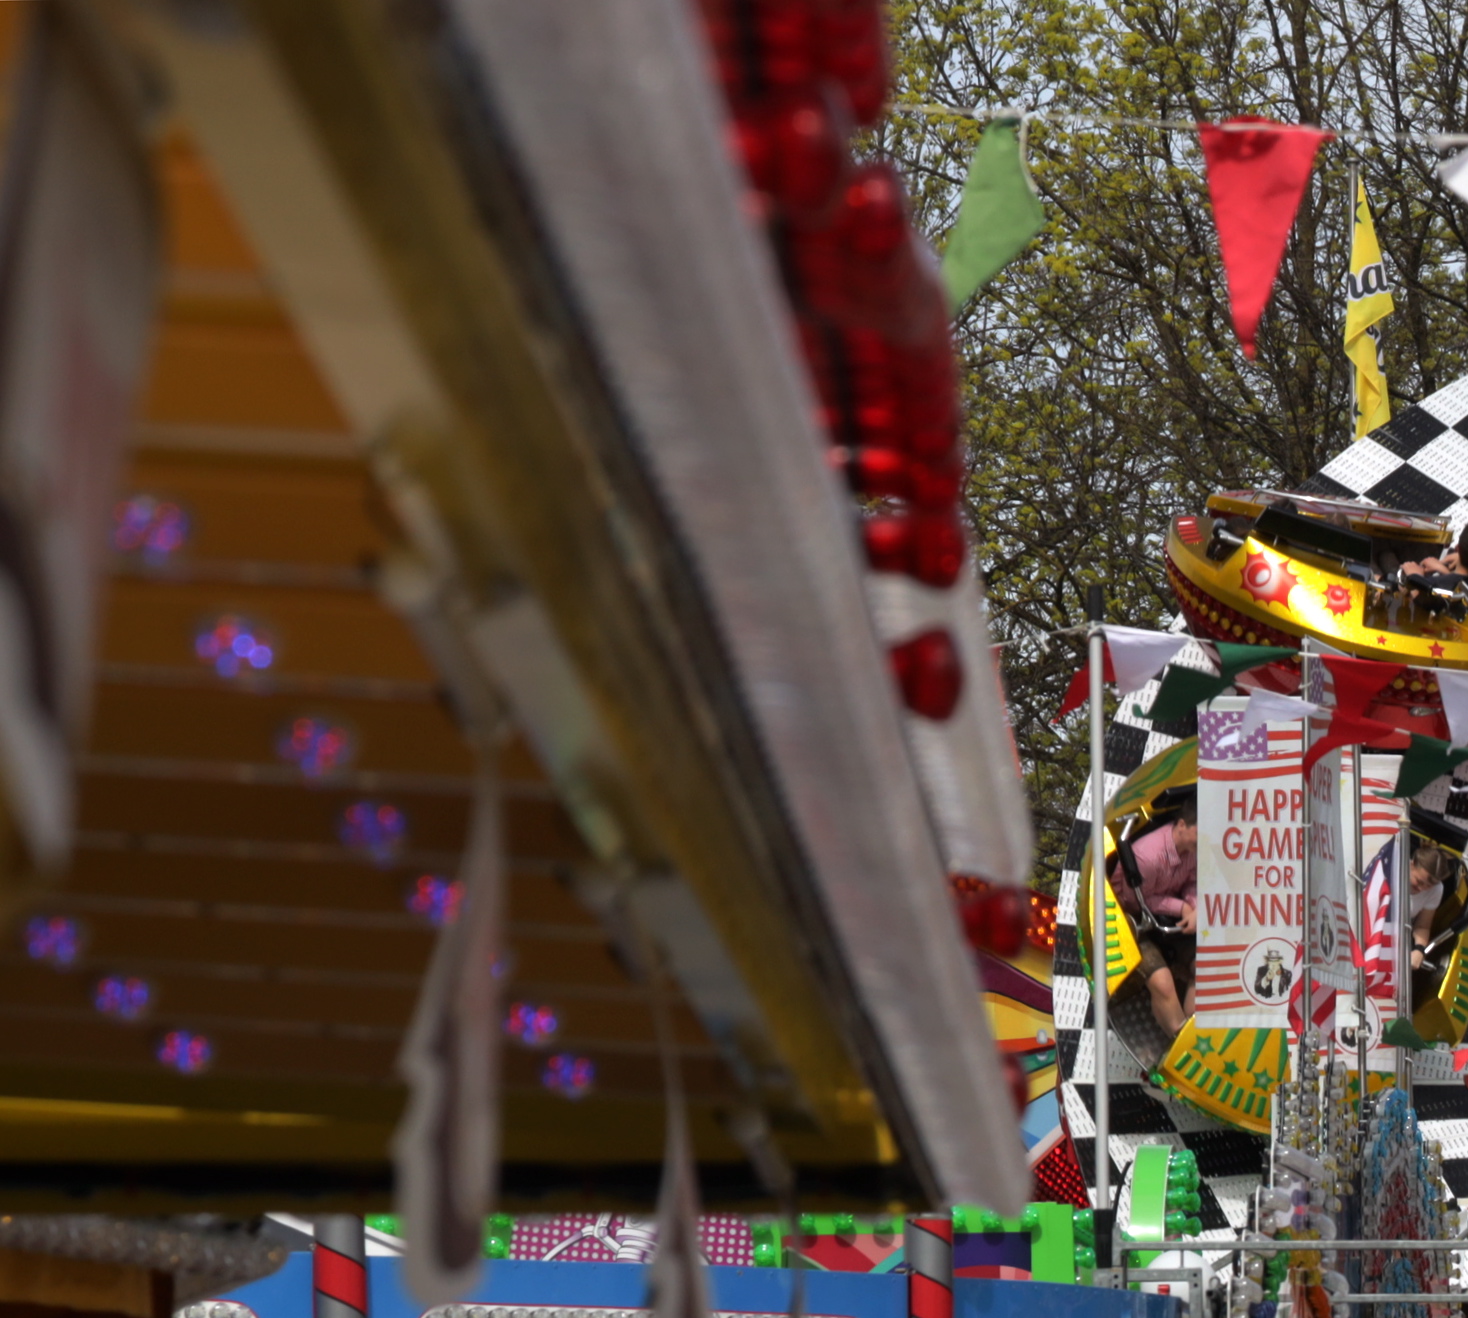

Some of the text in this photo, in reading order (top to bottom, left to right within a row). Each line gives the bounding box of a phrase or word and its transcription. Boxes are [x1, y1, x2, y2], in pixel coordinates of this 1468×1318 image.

[1227, 788, 1303, 822] HAPP
[1222, 827, 1303, 861] GAME
[1254, 865, 1294, 888] FOR
[1204, 893, 1303, 927] WINNE
